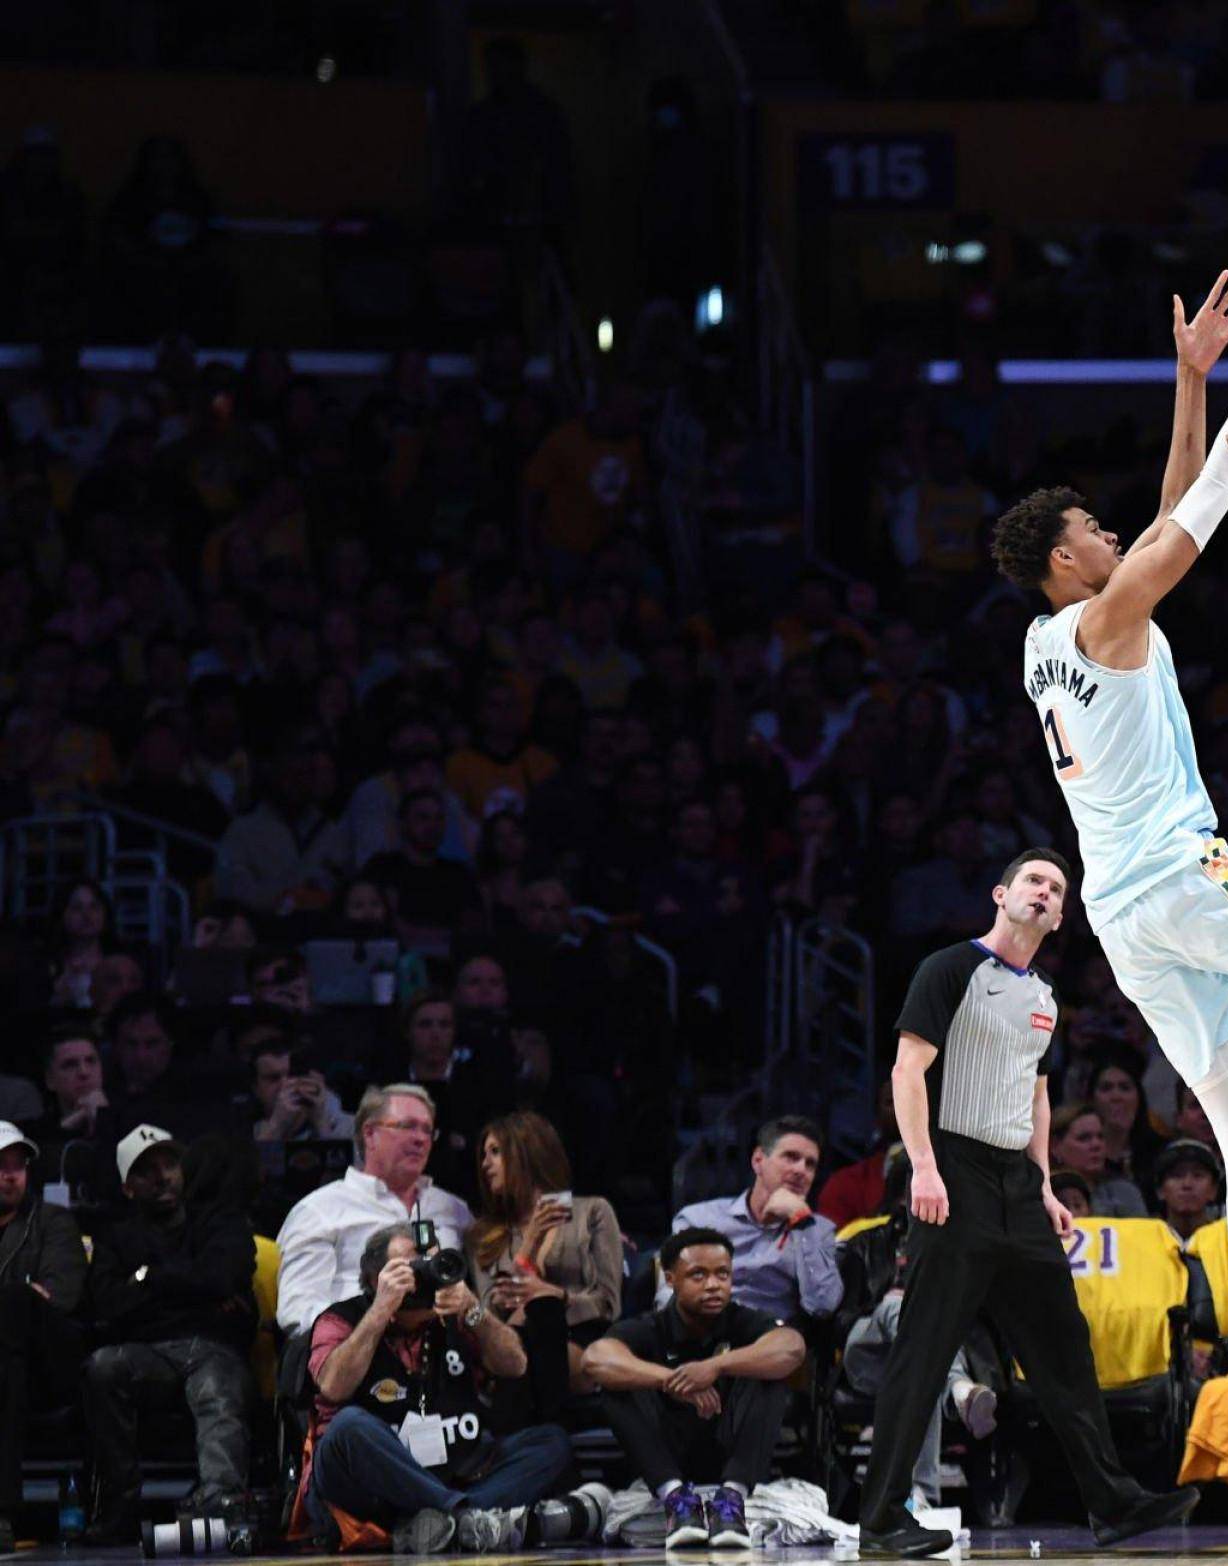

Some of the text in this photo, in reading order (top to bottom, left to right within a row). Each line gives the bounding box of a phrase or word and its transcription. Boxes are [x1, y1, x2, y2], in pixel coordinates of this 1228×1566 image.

[822, 143, 930, 200] 115
[1044, 708, 1077, 772] 1
[1067, 1227, 1114, 1270] 21
[445, 1349, 466, 1377] 8
[441, 1411, 480, 1446] TO
